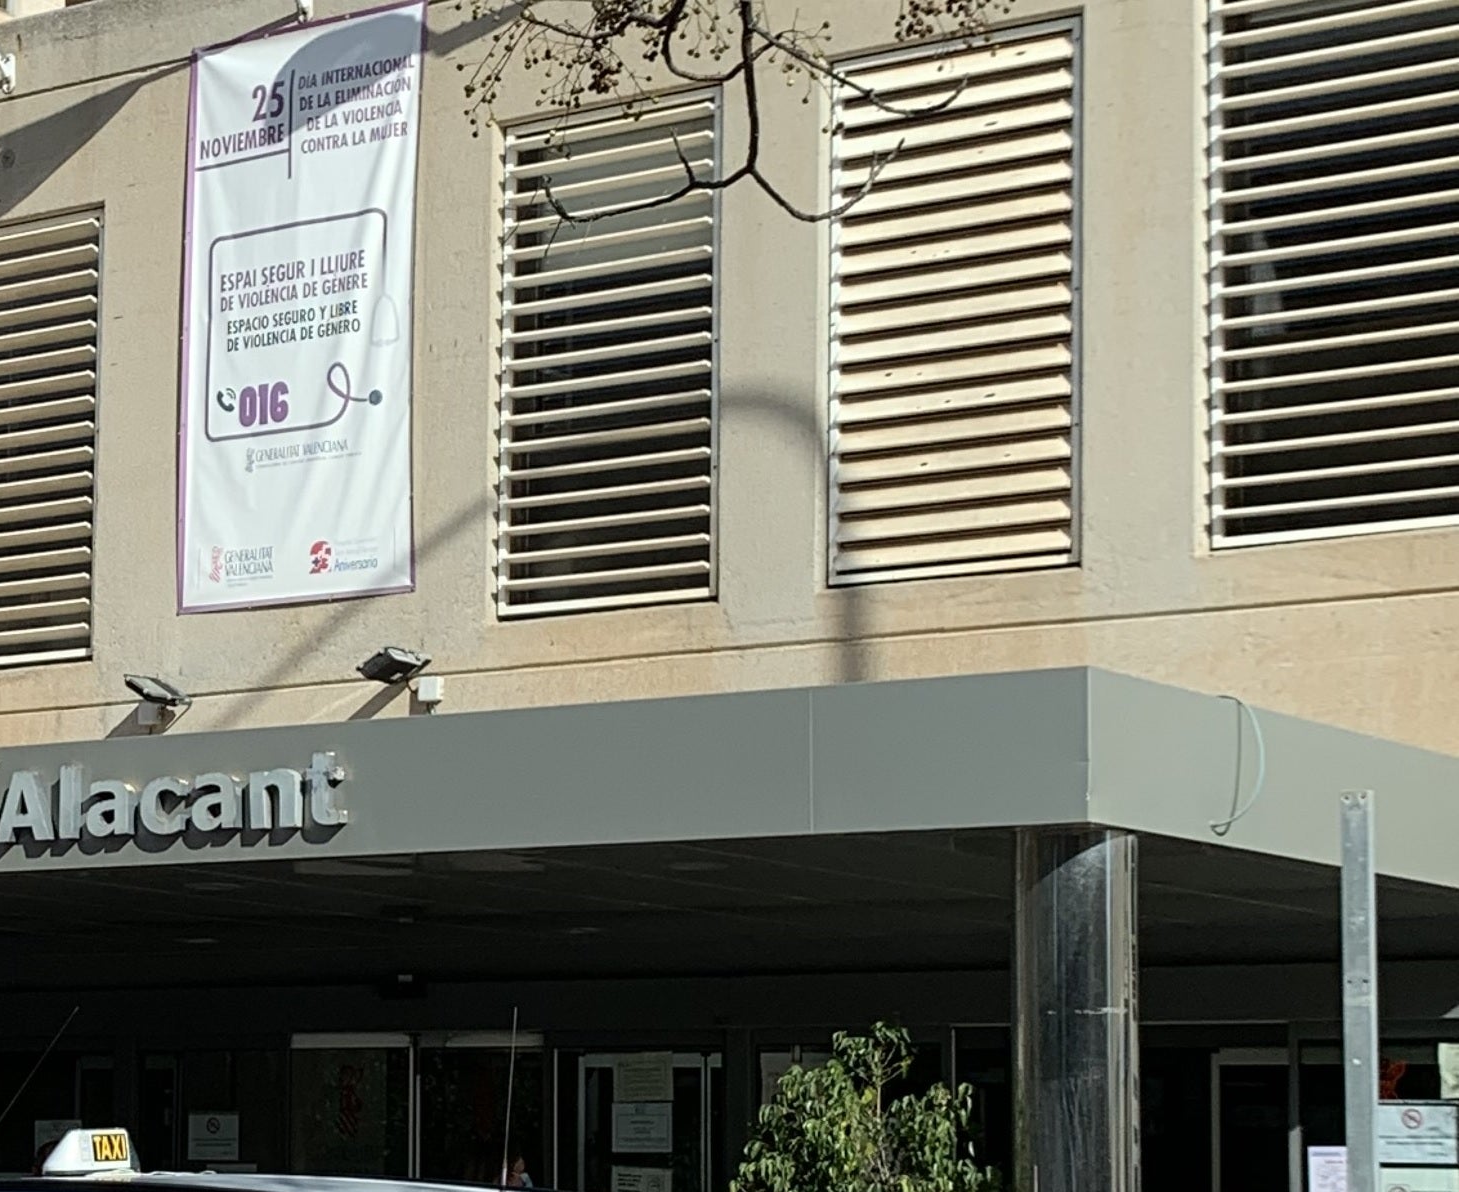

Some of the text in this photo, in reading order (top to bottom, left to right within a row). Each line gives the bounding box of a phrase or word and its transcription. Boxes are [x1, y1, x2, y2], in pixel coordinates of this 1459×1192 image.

[321, 53, 415, 85] INTERNACIONAL
[252, 80, 285, 122] 25
[299, 95, 314, 112] DE
[317, 91, 331, 107] LA
[307, 99, 403, 132] DE LA VIOLENCIA
[200, 123, 285, 160] NOVIEMBRE
[301, 120, 408, 154] CONTRA LA MUJER
[220, 249, 365, 293] ESPAI SEGUR I LLIURE
[220, 295, 235, 313] DE
[303, 281, 318, 299] DE
[227, 300, 358, 336] ESPACIO SEGURO Y LIBRE
[227, 338, 240, 353] DE
[243, 327, 297, 351] VIOLENCIA
[300, 325, 314, 341] DE
[239, 381, 289, 428] 016
[93, 1135, 126, 1160] TAXI
